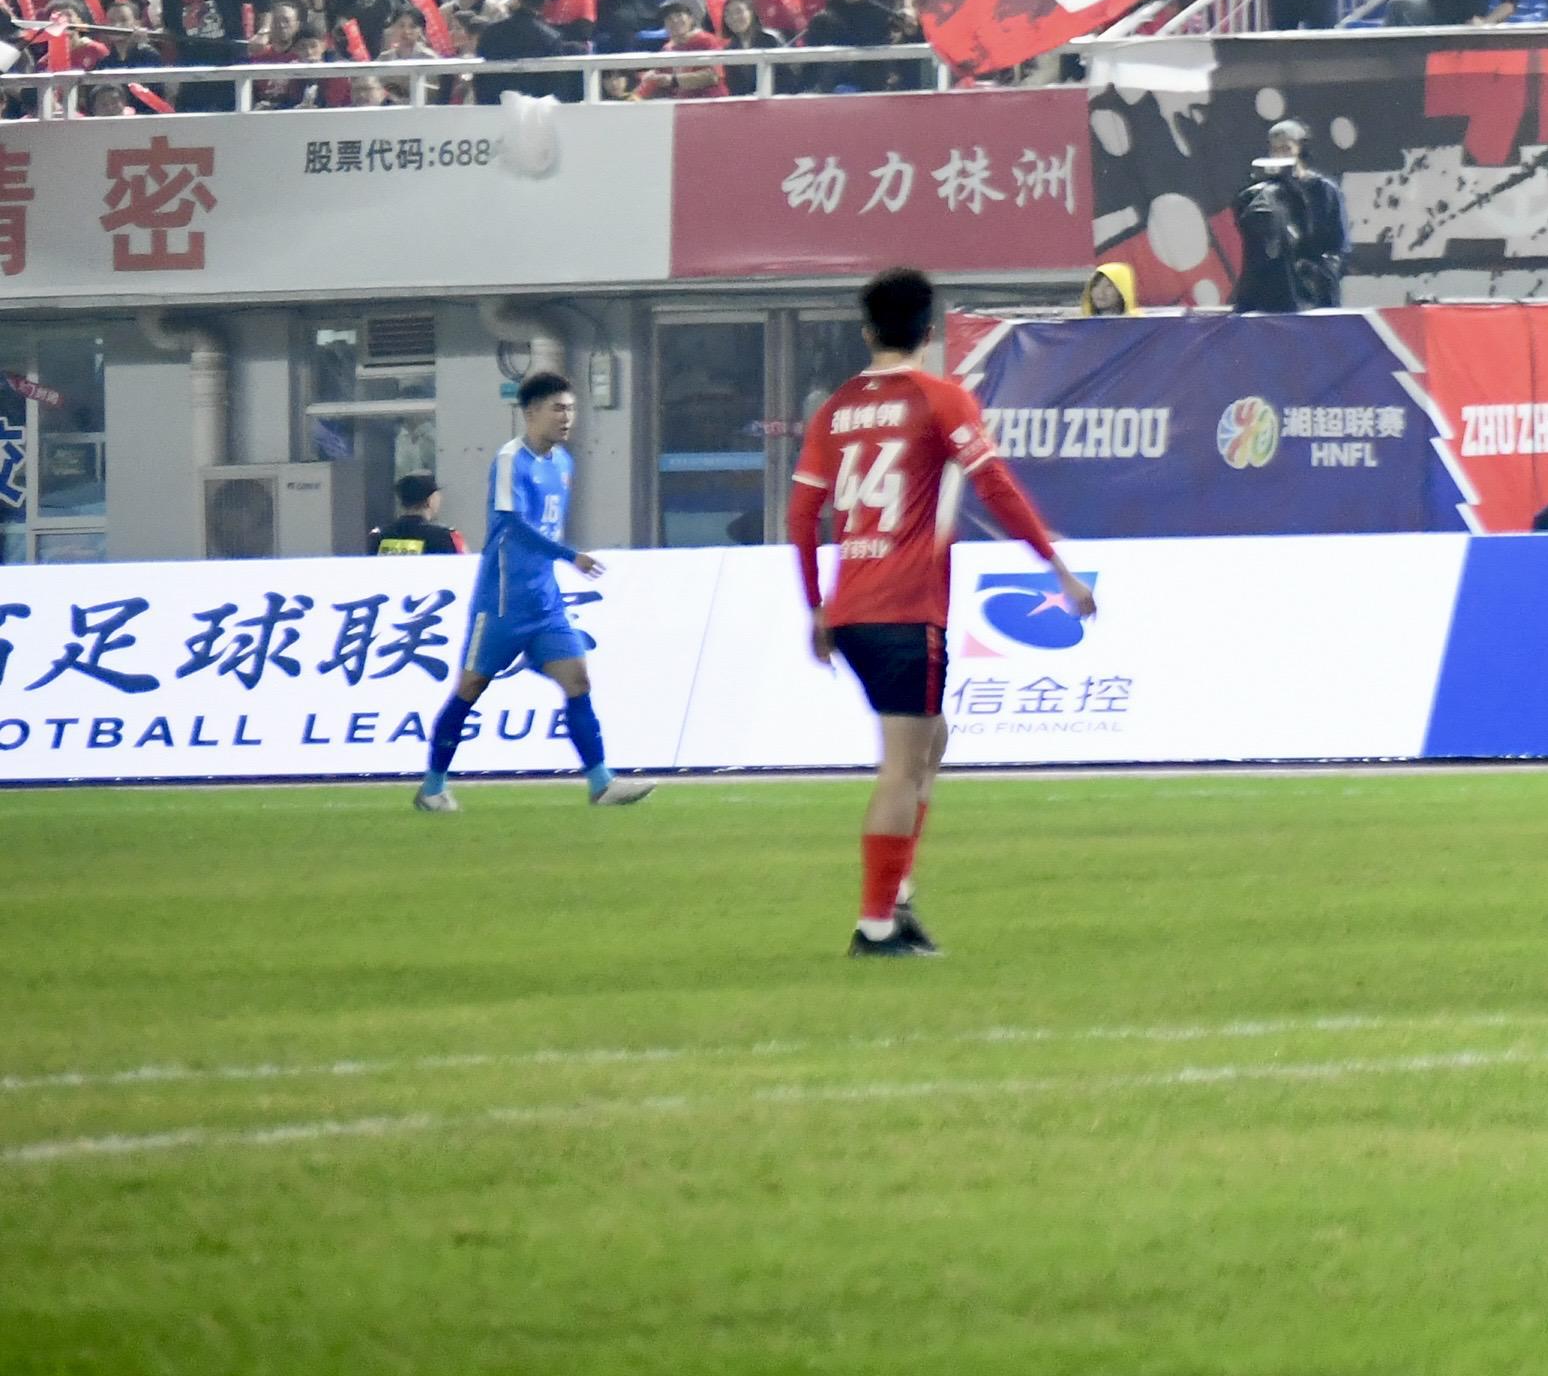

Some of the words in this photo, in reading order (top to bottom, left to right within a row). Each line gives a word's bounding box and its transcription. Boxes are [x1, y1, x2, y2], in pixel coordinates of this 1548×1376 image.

[304, 138, 497, 175] 股票代码:688
[781, 144, 1079, 218] 动力株洲
[1282, 405, 1407, 439] 湘超联赛
[1311, 443, 1378, 469] HNFL
[833, 440, 908, 534] 44
[0, 588, 604, 696] 足球联
